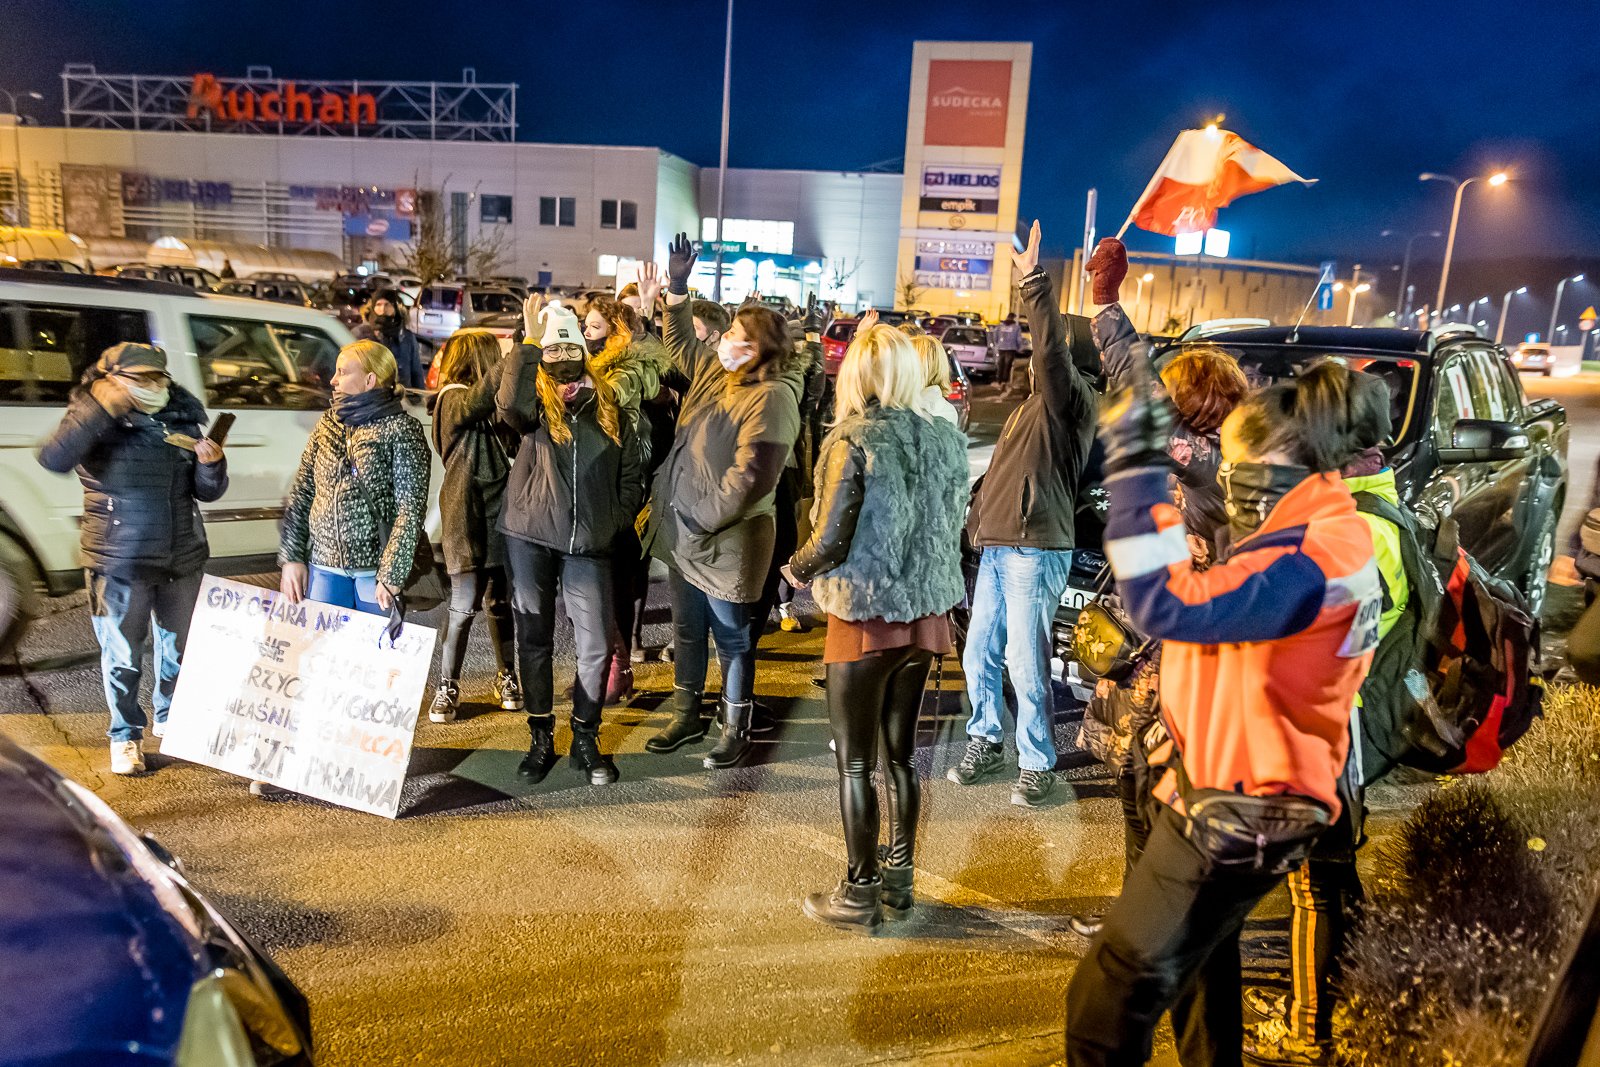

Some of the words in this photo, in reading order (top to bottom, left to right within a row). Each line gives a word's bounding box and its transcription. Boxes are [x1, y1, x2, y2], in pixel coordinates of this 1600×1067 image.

[187, 72, 376, 124] Auchan
[932, 96, 1002, 108] SUDECKA
[948, 173, 999, 187] HELIOS
[941, 198, 976, 212] empik
[940, 259, 968, 270] CCC
[928, 273, 977, 289] CARRY
[207, 586, 244, 611] GDY
[248, 596, 308, 628] OFIARA
[315, 609, 350, 632] NIE
[304, 755, 399, 811] PRAWA
